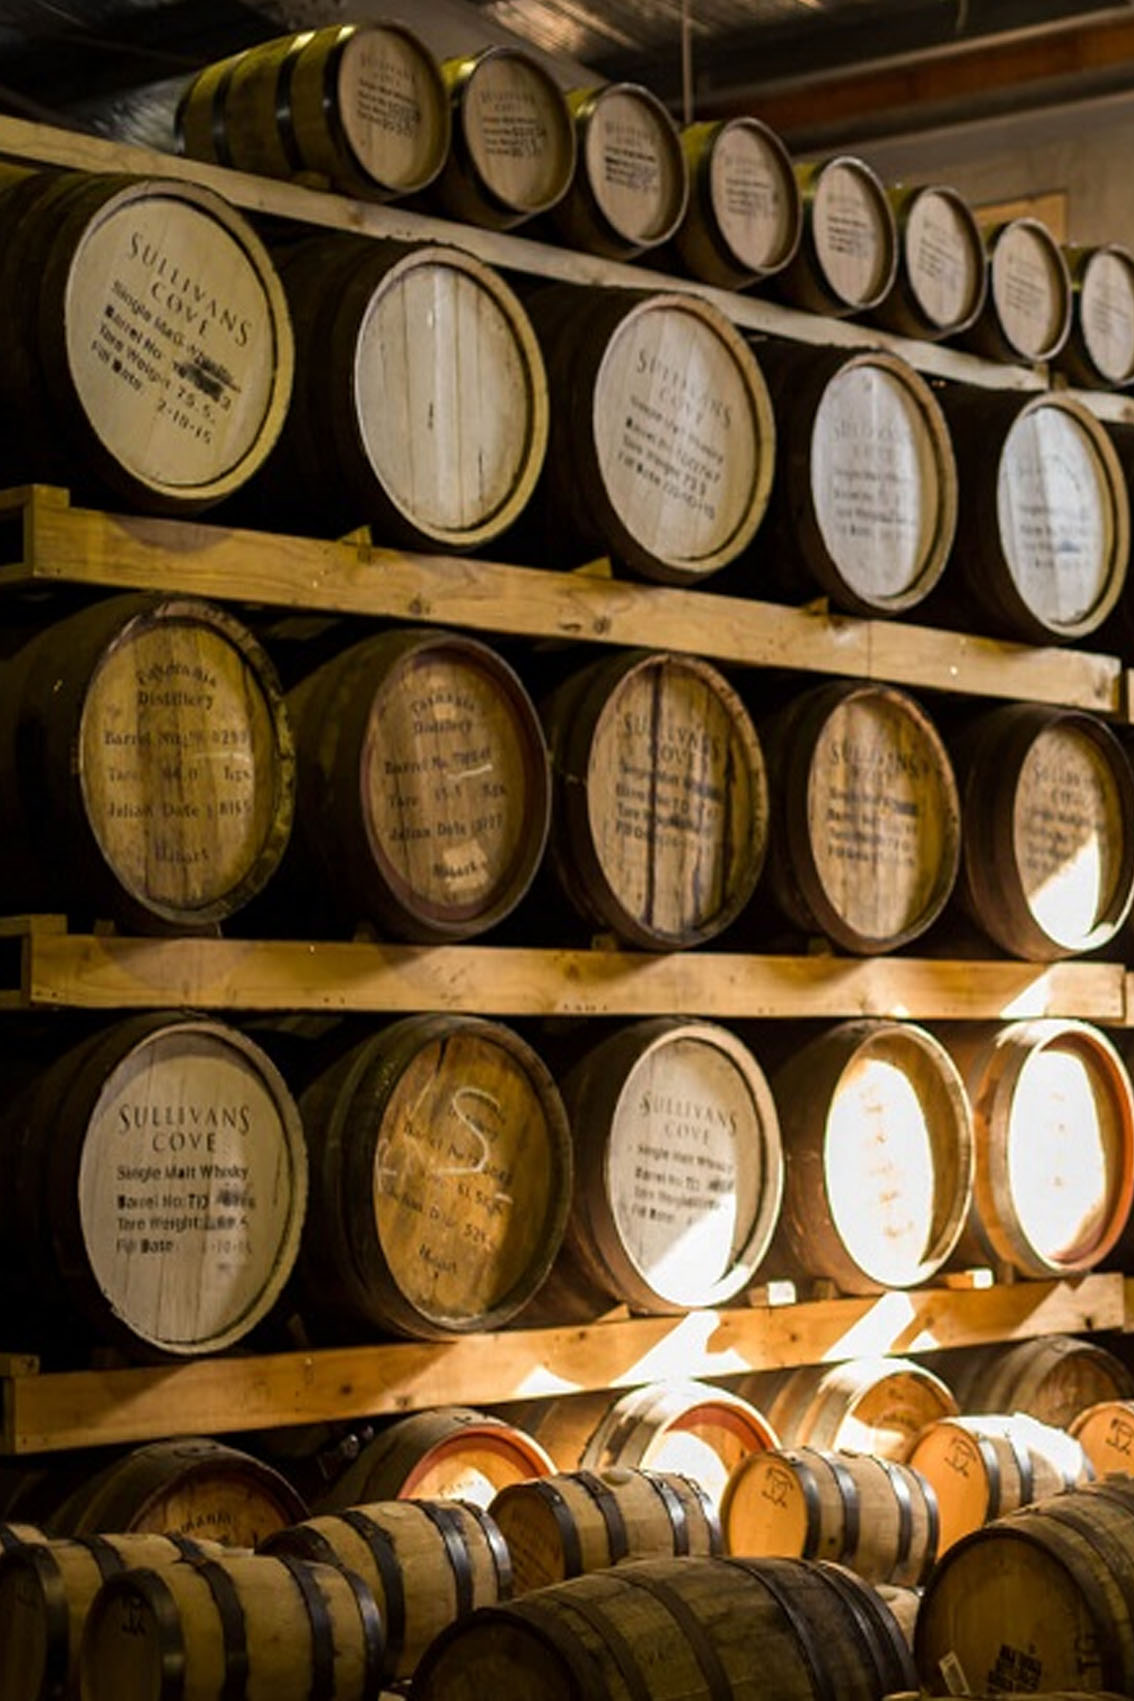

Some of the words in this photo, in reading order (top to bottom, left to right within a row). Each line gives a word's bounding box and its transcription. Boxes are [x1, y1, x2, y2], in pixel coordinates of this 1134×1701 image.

[130, 231, 252, 348] SULLIVANS
[151, 281, 208, 338] COVE
[136, 691, 215, 711] Distillery
[118, 1103, 250, 1136] SULLIVANS
[639, 1089, 738, 1138] SULLIVANS
[152, 1131, 217, 1153] COVE
[117, 1165, 163, 1184] Single
[165, 1165, 196, 1181] Malt
[200, 1165, 249, 1182] Whisky
[116, 1193, 159, 1211] Barrel
[117, 1216, 146, 1232] Tare
[140, 1238, 175, 1254] Date
